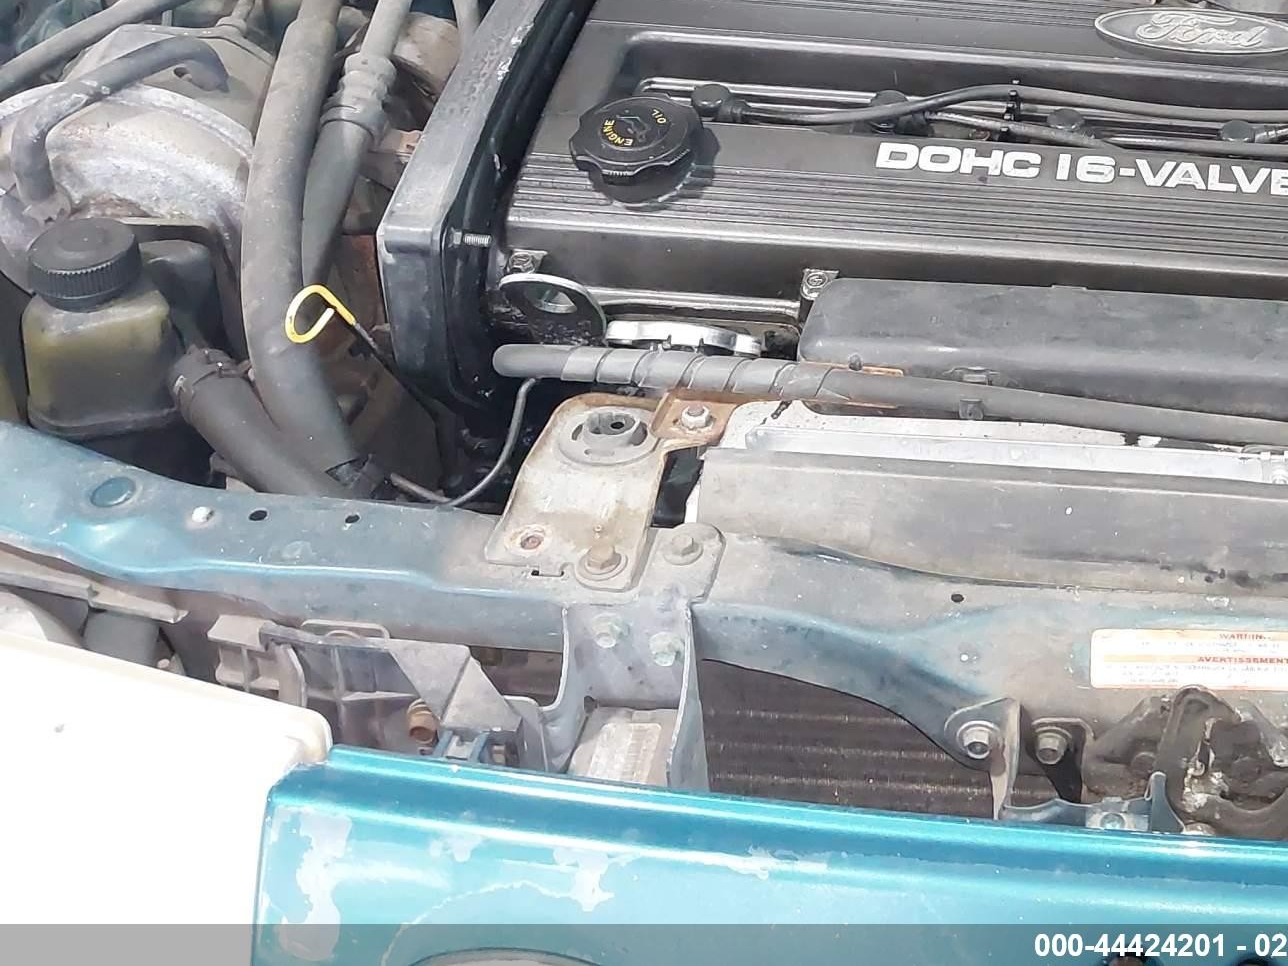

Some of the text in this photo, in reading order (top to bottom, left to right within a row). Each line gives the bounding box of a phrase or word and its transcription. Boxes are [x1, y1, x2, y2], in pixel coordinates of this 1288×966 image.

[1135, 11, 1267, 48] Ford
[602, 109, 667, 146] ENGINE OIL
[875, 142, 1042, 179] DOHC
